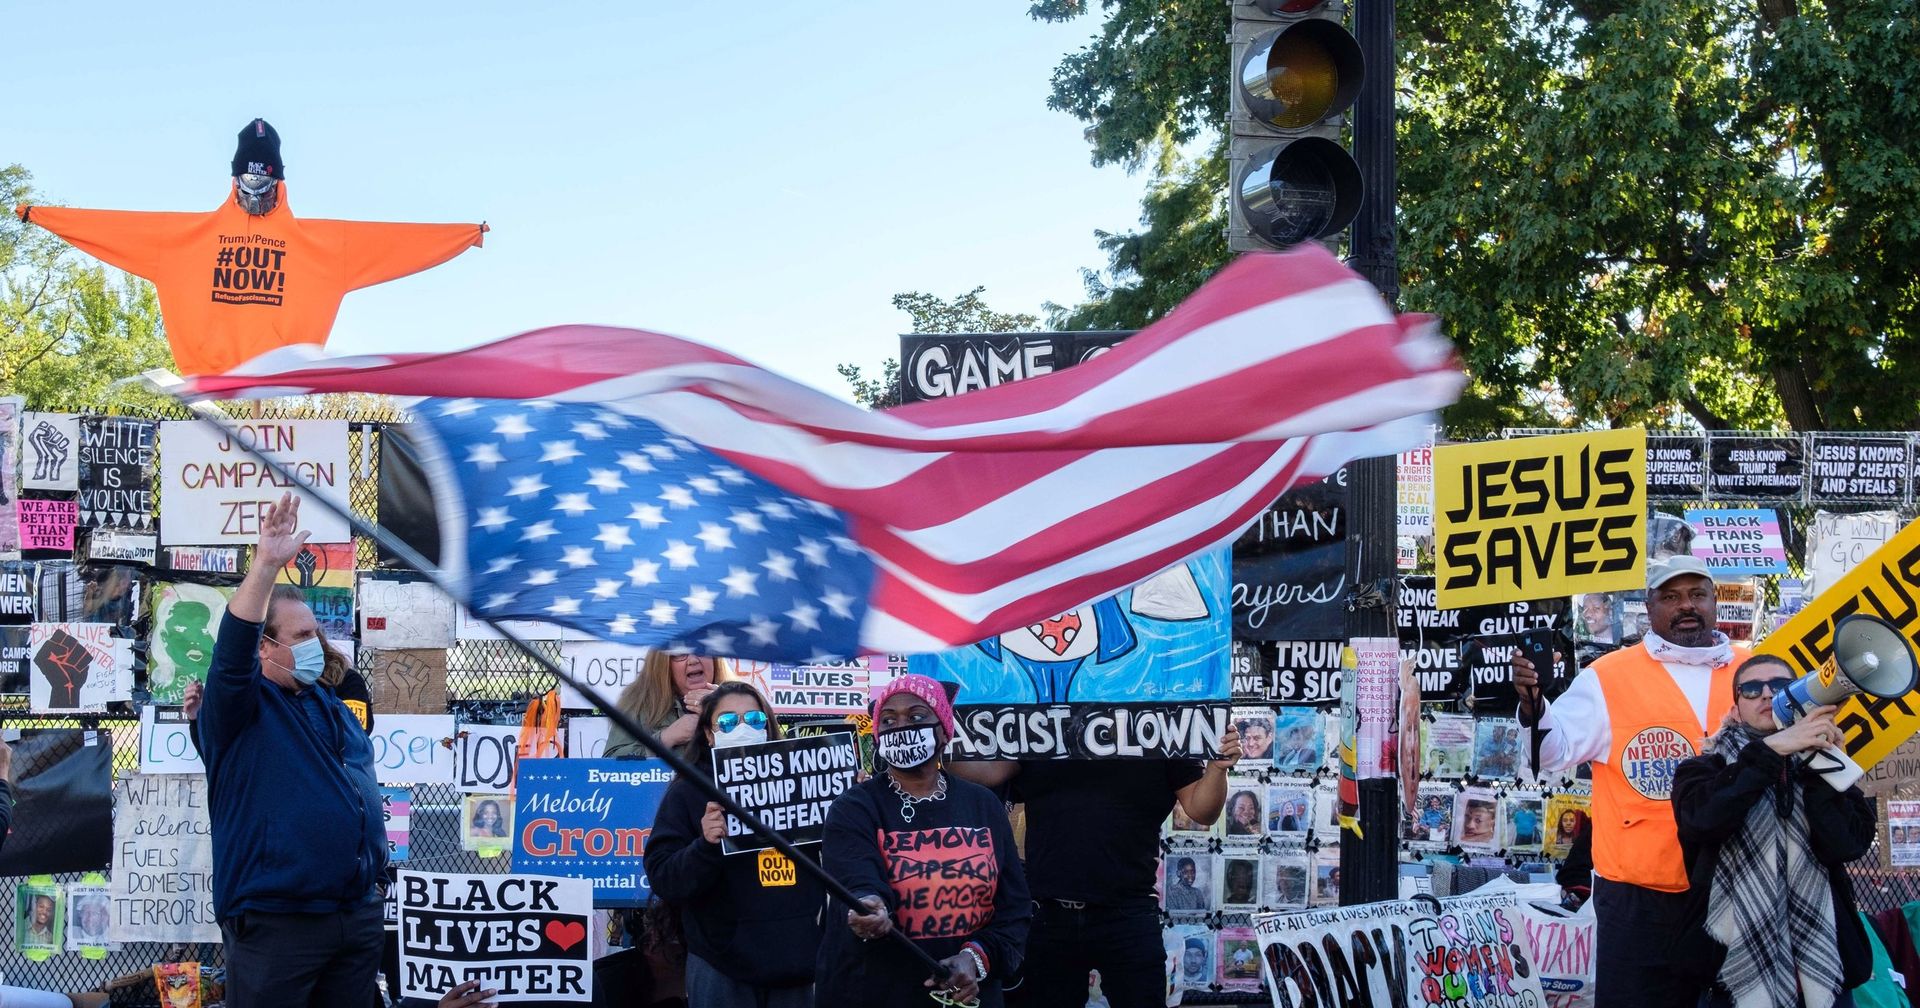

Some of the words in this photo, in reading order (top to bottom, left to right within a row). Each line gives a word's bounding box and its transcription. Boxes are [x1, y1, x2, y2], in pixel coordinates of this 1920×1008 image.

[218, 235, 286, 248] Trump/Pence
[217, 246, 286, 270] #OUT
[213, 268, 285, 292] NOW!
[215, 293, 280, 303] RefuseFascism.org
[916, 345, 1053, 397] GAME
[86, 421, 152, 448] WHITE
[218, 425, 294, 452] JOIN
[80, 447, 148, 465] SILENCE
[1402, 449, 1432, 465] TER
[1656, 449, 1691, 460] KNOWS
[1728, 451, 1755, 461] JESUS
[1757, 451, 1786, 462] KNOWS
[1817, 446, 1855, 460] JESUS
[1860, 447, 1904, 461] KNOWS
[182, 462, 334, 489] CAMPAIGN
[1404, 466, 1431, 474] RIGHTS
[1646, 462, 1702, 473] SUPREMACY
[1739, 463, 1767, 474] TRUMP
[1769, 463, 1776, 473] IS
[1814, 462, 1855, 476] TRUMP
[1859, 463, 1905, 478] CHEATS
[104, 468, 121, 487] IS
[1407, 475, 1431, 483] RIGHTS
[1445, 443, 1635, 523] JESUS
[1647, 475, 1652, 485] E
[1655, 474, 1702, 485] DEFEATED
[1710, 475, 1715, 485] A
[1718, 475, 1744, 486] WHITE
[1746, 475, 1801, 486] SUPREMACIST
[1821, 479, 1846, 492] AND
[1850, 479, 1896, 493] STEALS
[1408, 483, 1431, 491] BEING
[22, 502, 43, 512] WE
[47, 502, 75, 512] ARE
[78, 490, 150, 512] VIOLENCE
[1399, 492, 1430, 504] EGAL
[21, 514, 77, 524] BETTER
[220, 501, 297, 535] ZER
[1401, 506, 1408, 514] IS
[1410, 506, 1430, 514] REAL
[1258, 507, 1339, 541] THAN
[1405, 516, 1429, 525] LOVE
[1704, 517, 1760, 527] BLACK
[1820, 520, 1841, 538] WE
[28, 525, 68, 535] THAN
[1706, 530, 1763, 540] TRANS
[31, 536, 66, 546] THIS
[1713, 544, 1762, 553] LIVES
[174, 549, 234, 572] AmeriKKKa
[1402, 549, 1414, 558] DIE
[1444, 515, 1638, 590] SAVES
[1706, 557, 1775, 567] MATTER
[1231, 573, 1345, 629] ayers
[1400, 588, 1436, 607] RONG
[1509, 602, 1528, 613] IS
[1398, 609, 1412, 627] RE
[1417, 610, 1460, 627] WEAK
[77, 624, 115, 649] LIVES
[4, 647, 31, 660] CAMPS
[84, 643, 115, 671] MATTER
[1482, 645, 1518, 665] WHA
[792, 673, 853, 687] LIVES
[1475, 666, 1505, 684] YOU
[1271, 671, 1295, 697] IS
[1304, 671, 1341, 698] SIC
[169, 690, 185, 703] HE
[774, 691, 863, 706] MATTER
[883, 728, 926, 747] LEGALIZE
[945, 707, 1071, 756] ASCIST
[1084, 707, 1227, 756] CLOWN
[1638, 732, 1675, 745] GOOD
[374, 729, 441, 769] oser
[885, 745, 928, 763] BLACKNESS
[1628, 743, 1688, 760] NEWS!
[718, 753, 784, 783] JESUS
[789, 744, 855, 774] KNOWS
[1629, 759, 1676, 779] JESU
[1860, 757, 1920, 782] REONNA
[588, 769, 677, 786] Evangelist
[1640, 780, 1673, 793] SAVE
[119, 778, 204, 808] WHITE
[726, 779, 796, 808] TRUMP
[801, 771, 855, 799] MUST
[522, 789, 613, 822] Melody
[1890, 803, 1920, 814] WANT
[760, 800, 833, 831] DEFEAT
[122, 841, 178, 867] FUELS
[763, 857, 790, 869] OUT
[761, 870, 794, 882] NOW
[886, 854, 997, 881] IMPEACH
[403, 876, 559, 911] BLACK
[895, 887, 929, 910] HE
[114, 899, 216, 925] TERRORIS
[1254, 918, 1282, 935] TTER
[1288, 918, 1306, 931] ALL
[1307, 913, 1340, 927] BLACK
[1342, 907, 1369, 920] LIVES
[1371, 903, 1409, 918] MATTER
[1461, 899, 1481, 911] LIVES
[1482, 896, 1510, 909] MATTER
[406, 917, 541, 952] LIVES
[1409, 909, 1513, 951] TRANS
[1414, 943, 1530, 981] WOMENS
[406, 962, 585, 995] MATTER
[1421, 966, 1518, 1005] QUEER
[1553, 979, 1576, 990] Store
